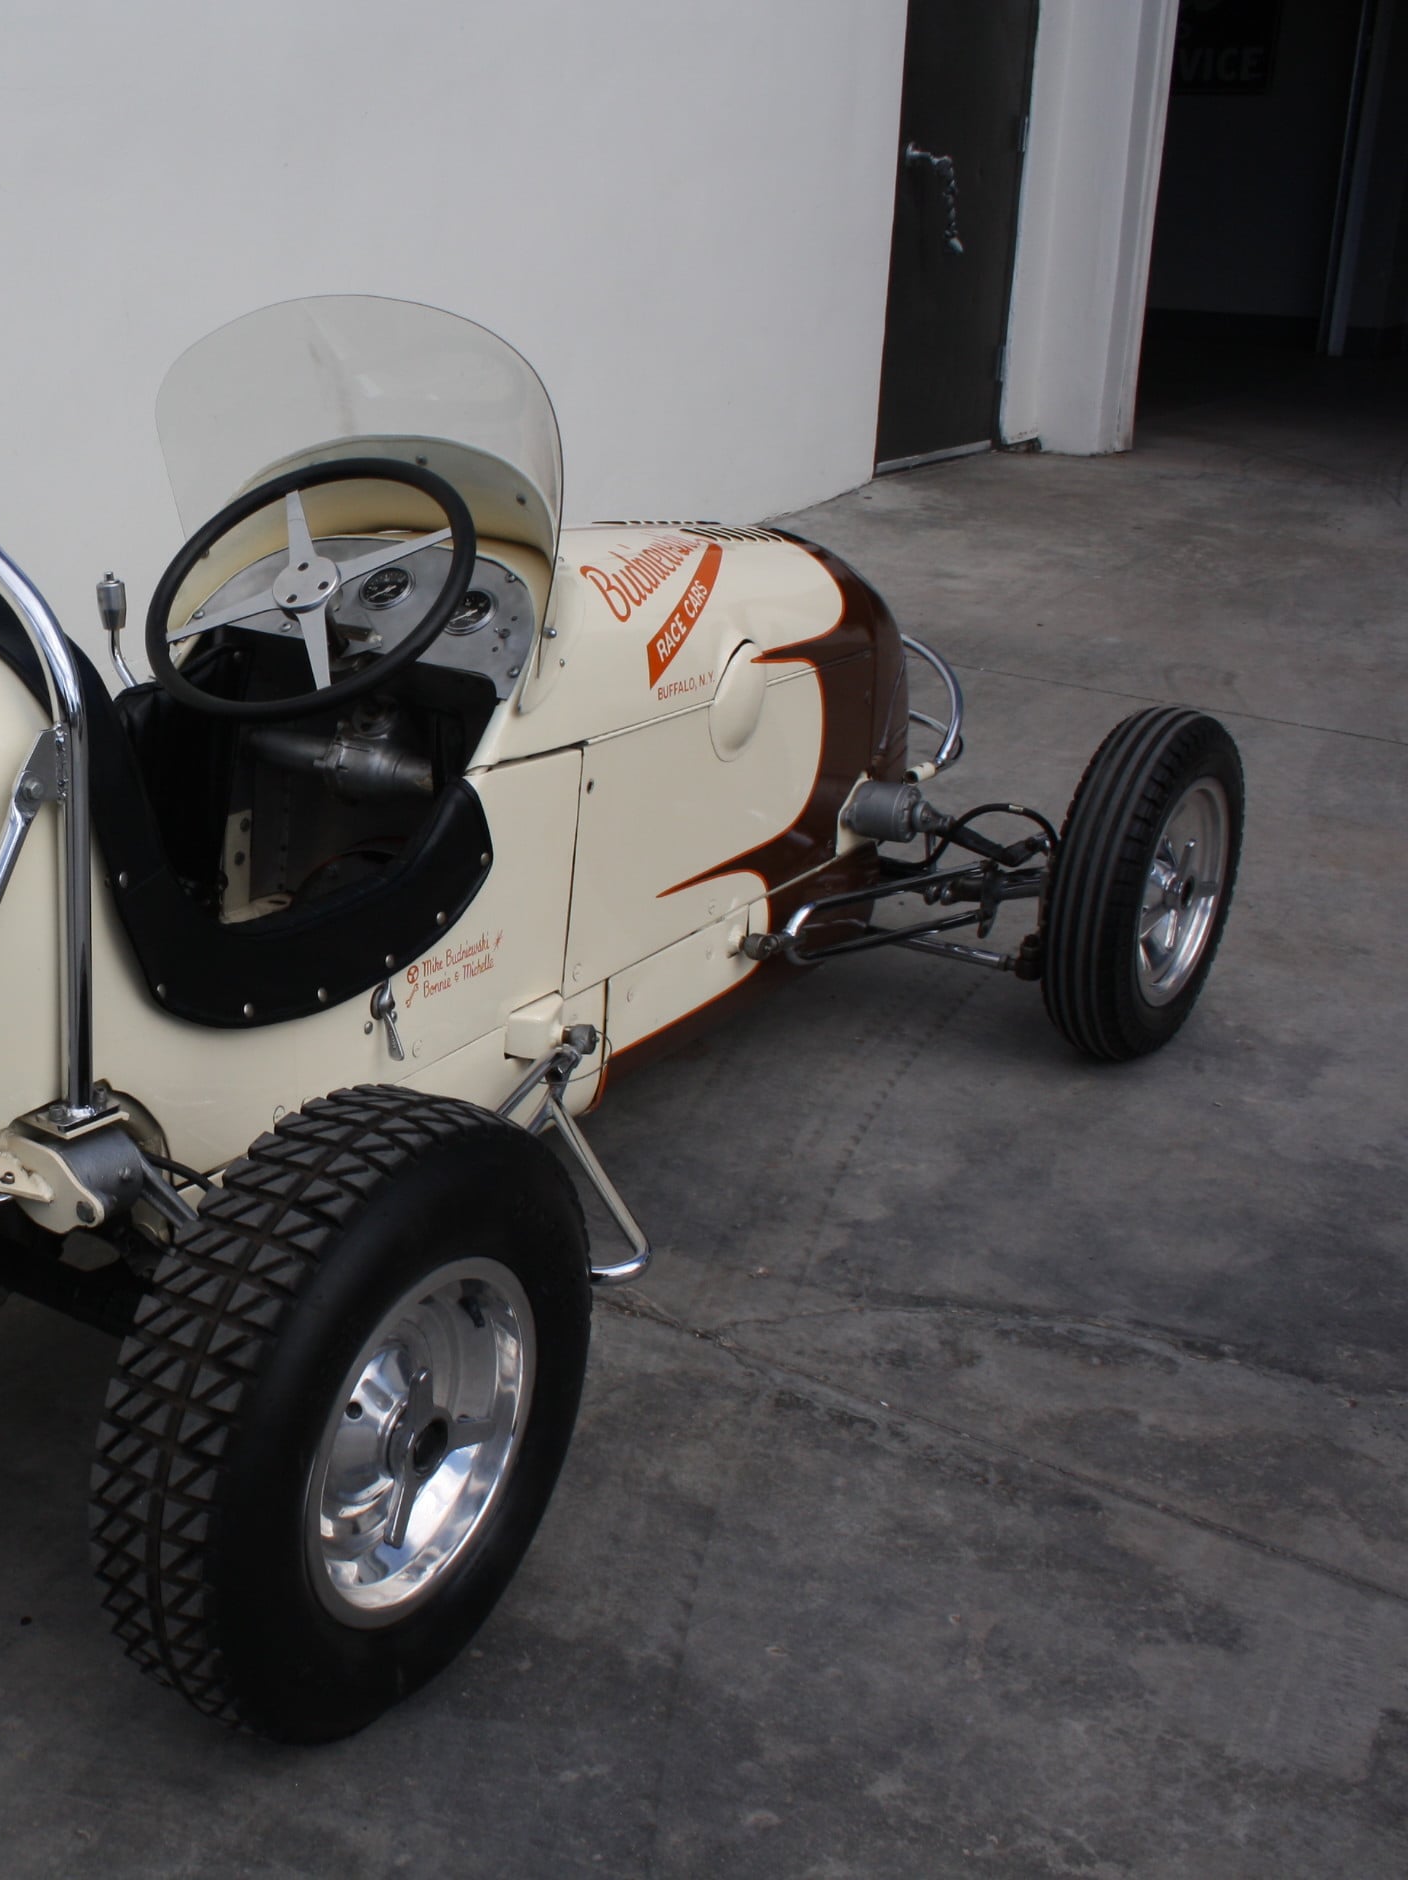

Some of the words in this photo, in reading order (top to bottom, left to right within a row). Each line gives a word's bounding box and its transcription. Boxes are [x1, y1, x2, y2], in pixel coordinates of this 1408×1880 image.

[656, 614, 687, 662] RACE
[684, 580, 708, 618] CARS
[658, 677, 697, 700] BUFFALO,
[422, 958, 443, 977] Mike
[423, 972, 452, 998] Bonnie
[462, 954, 495, 980] Michelle
